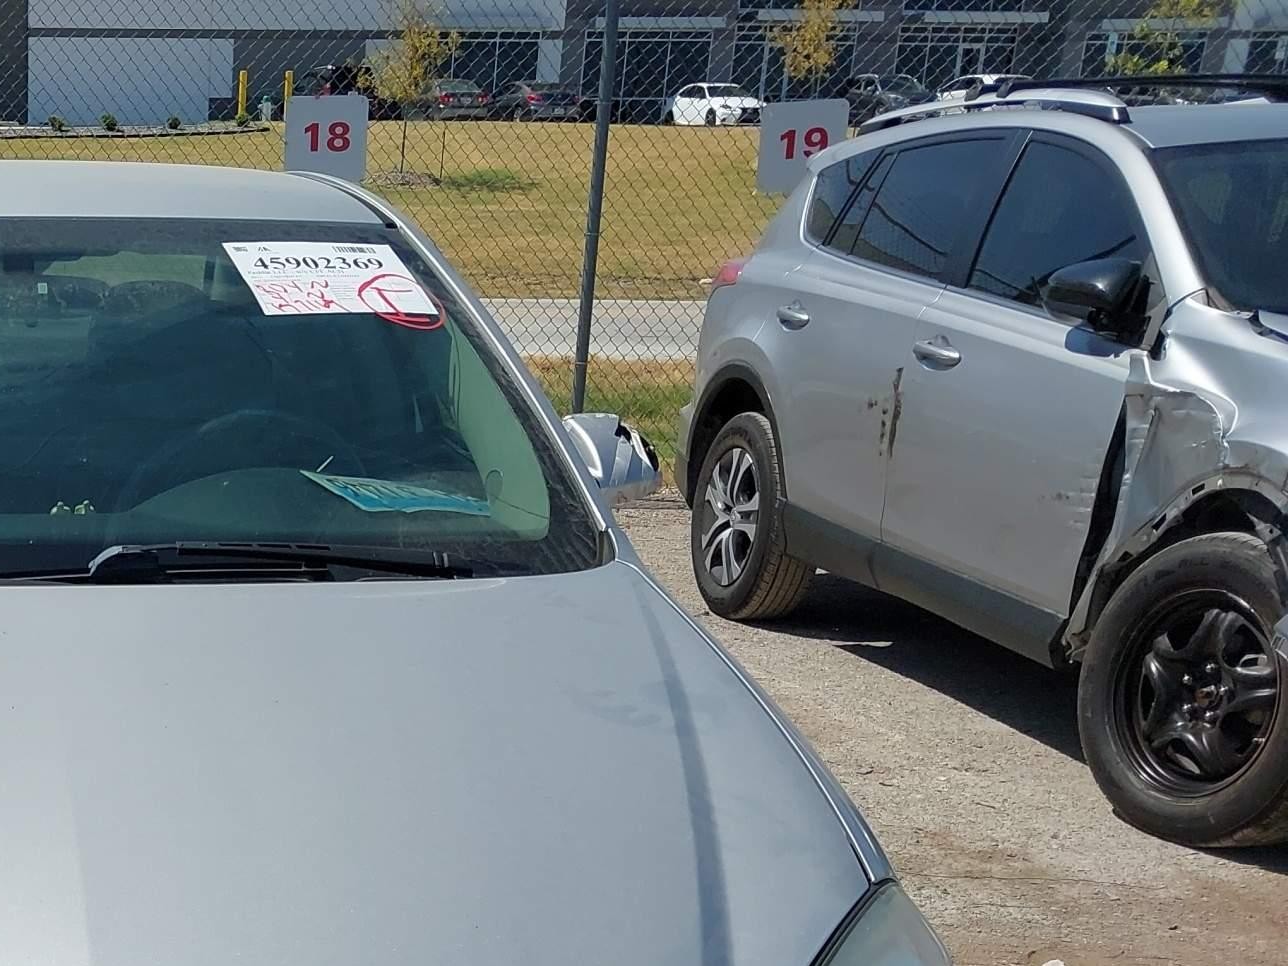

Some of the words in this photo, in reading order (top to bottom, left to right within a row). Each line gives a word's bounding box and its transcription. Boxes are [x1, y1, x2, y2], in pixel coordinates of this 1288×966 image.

[304, 121, 351, 153] 18
[780, 127, 829, 160] 19
[253, 256, 384, 270] 45902369
